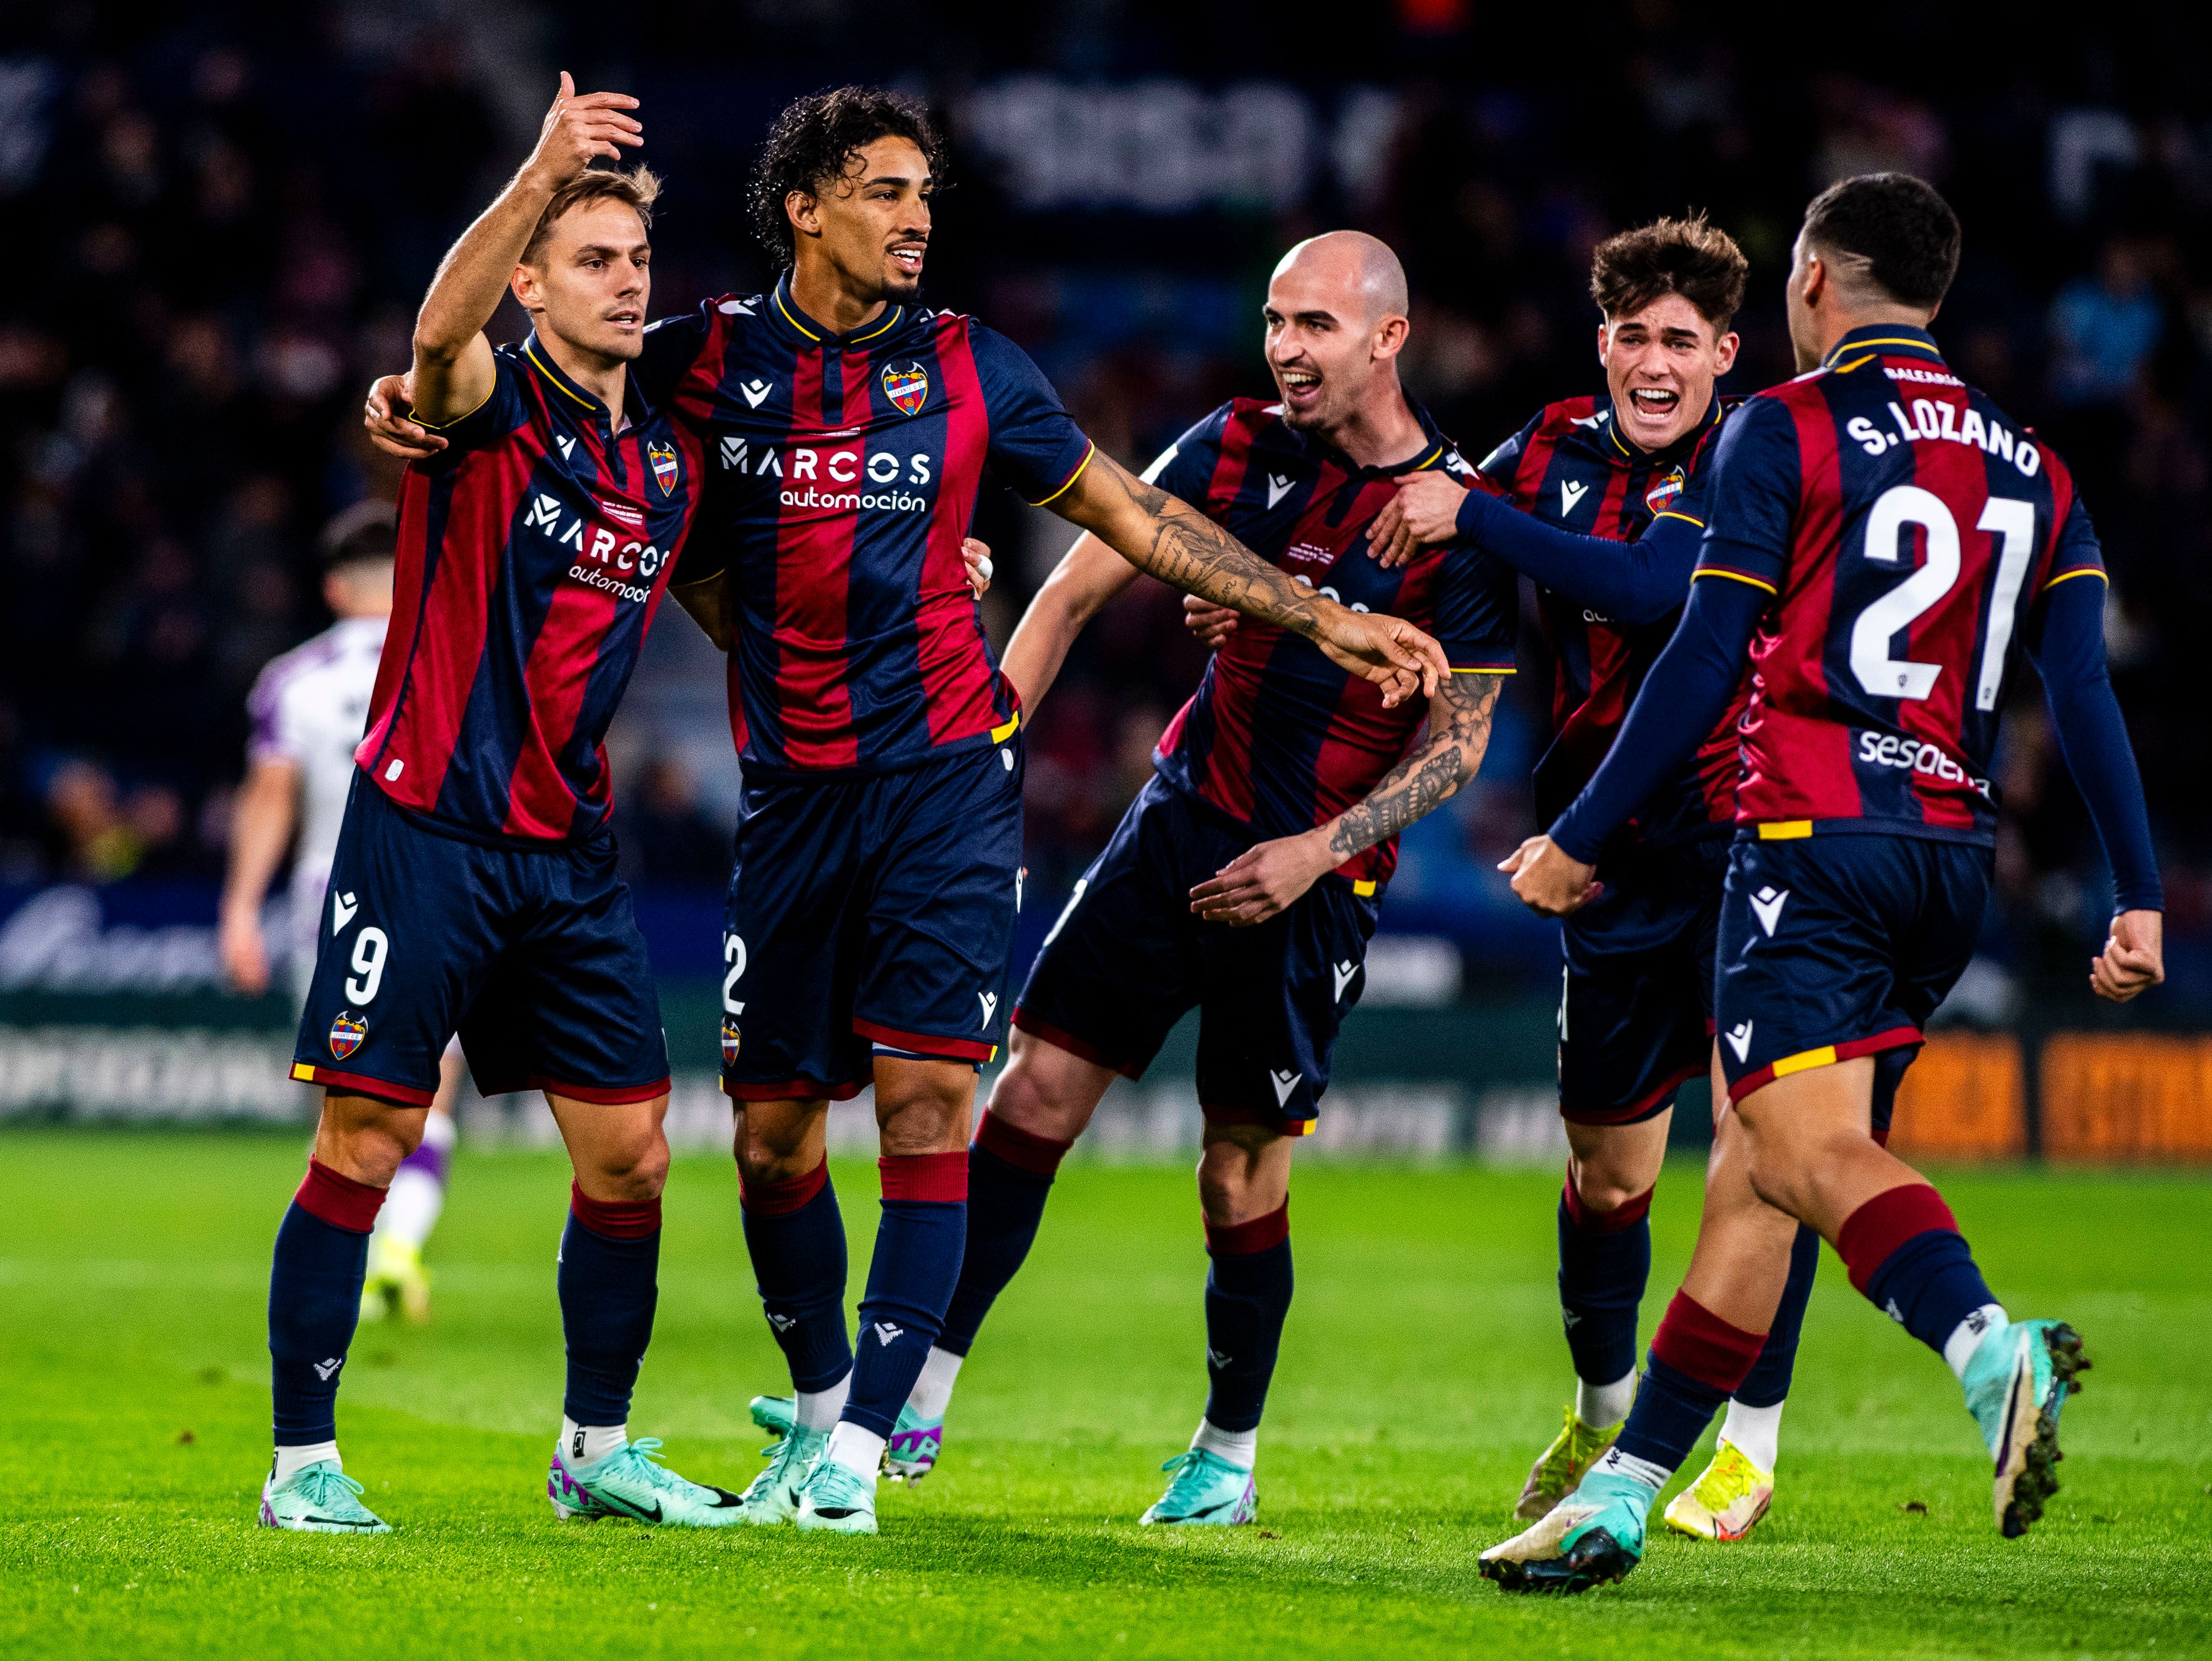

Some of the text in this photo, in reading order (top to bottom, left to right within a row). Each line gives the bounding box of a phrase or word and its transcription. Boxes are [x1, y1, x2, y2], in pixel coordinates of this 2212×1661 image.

[892, 386, 912, 397] LEVANTE
[720, 436, 930, 485] MARCOS
[780, 486, 926, 512] automoción
[1850, 485, 2035, 712] 21
[345, 927, 388, 1005] 9
